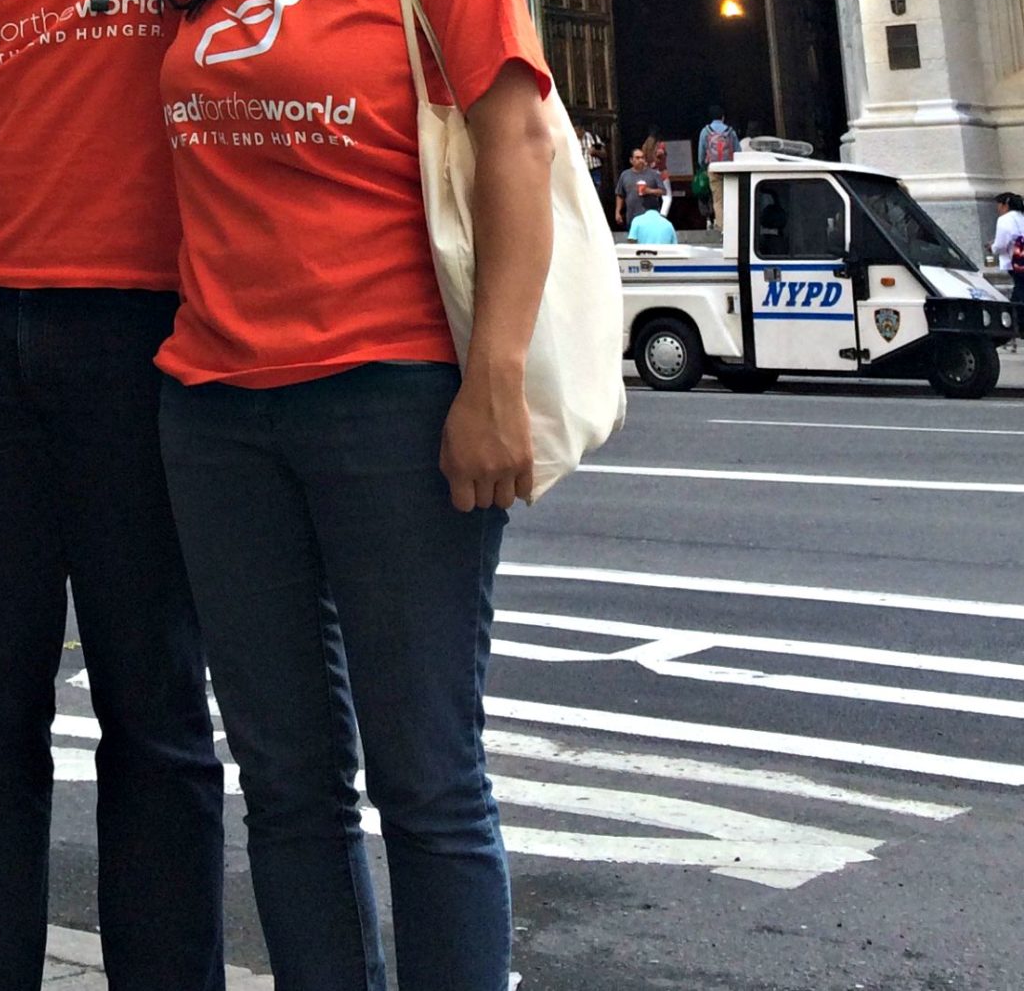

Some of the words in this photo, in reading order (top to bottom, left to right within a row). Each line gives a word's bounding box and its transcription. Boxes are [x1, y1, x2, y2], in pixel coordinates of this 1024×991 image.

[27, 31, 67, 47] ND
[232, 132, 265, 146] END
[761, 281, 843, 308] NYPD
